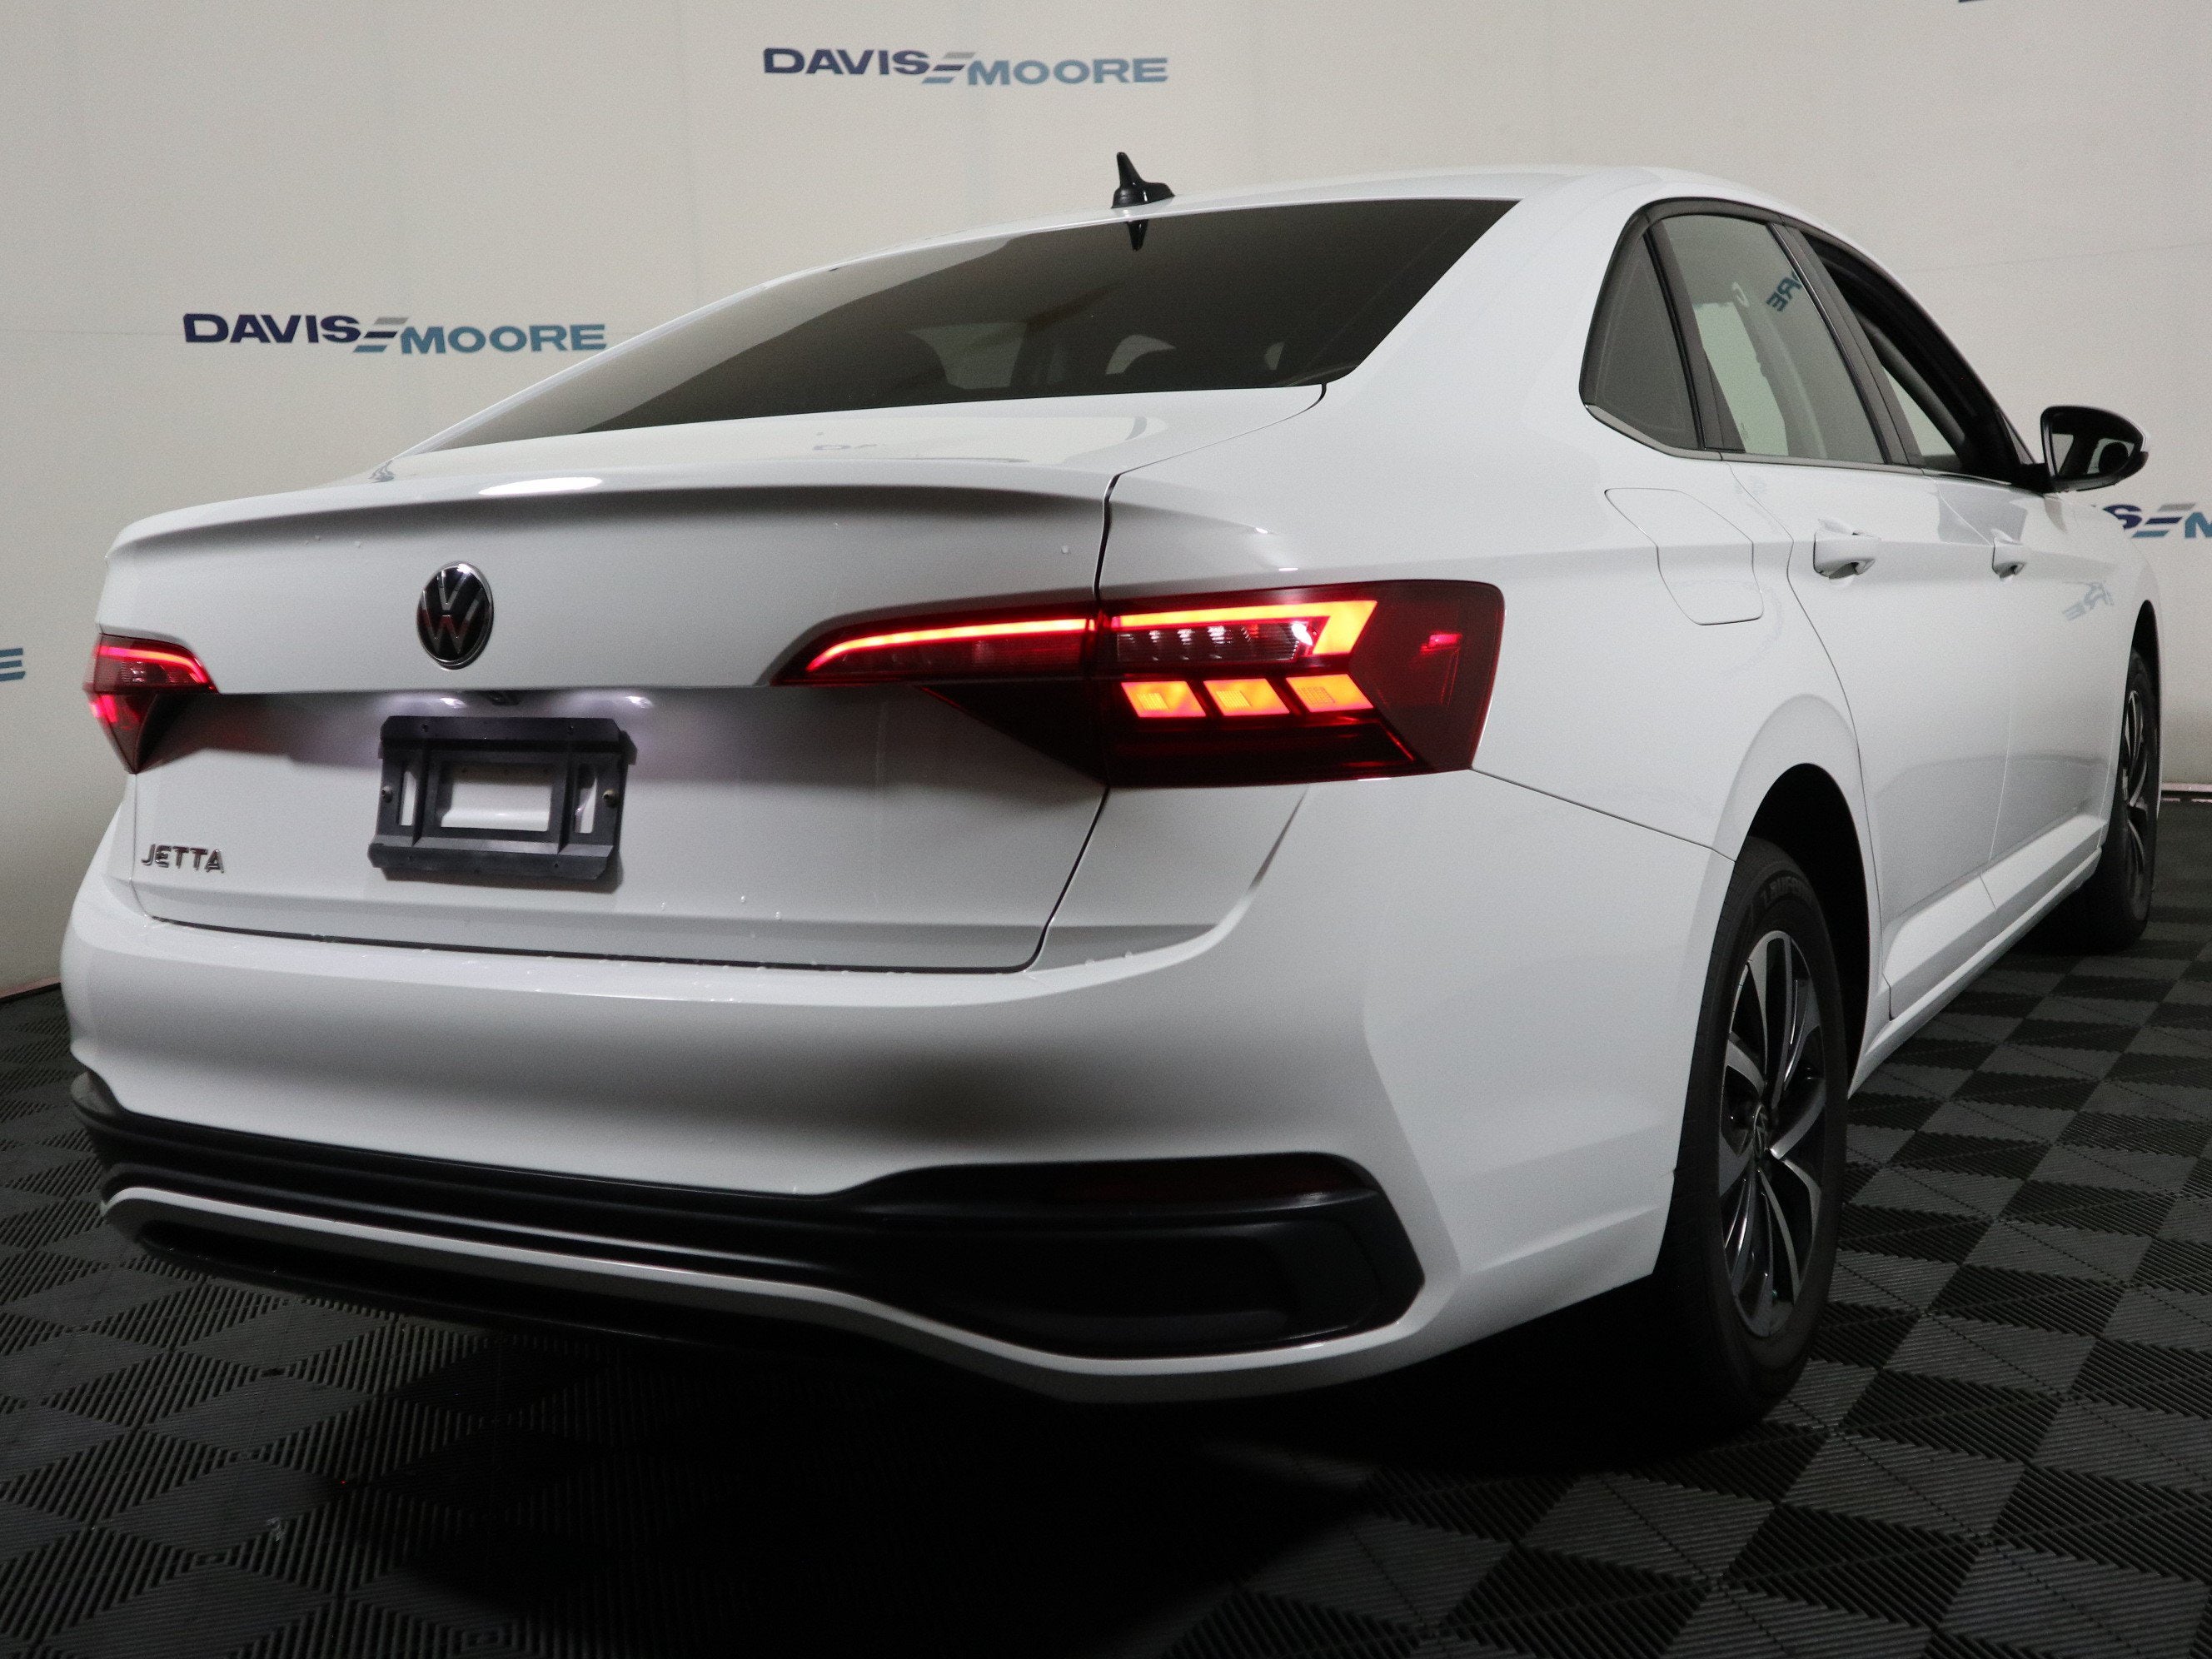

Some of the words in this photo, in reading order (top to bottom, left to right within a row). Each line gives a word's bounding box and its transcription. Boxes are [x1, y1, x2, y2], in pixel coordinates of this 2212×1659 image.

[763, 47, 929, 75] DAVIS
[967, 57, 1168, 86] MOORE
[182, 313, 359, 343] DAVIS
[401, 324, 605, 354] MOORE
[141, 844, 224, 874] JETTA
